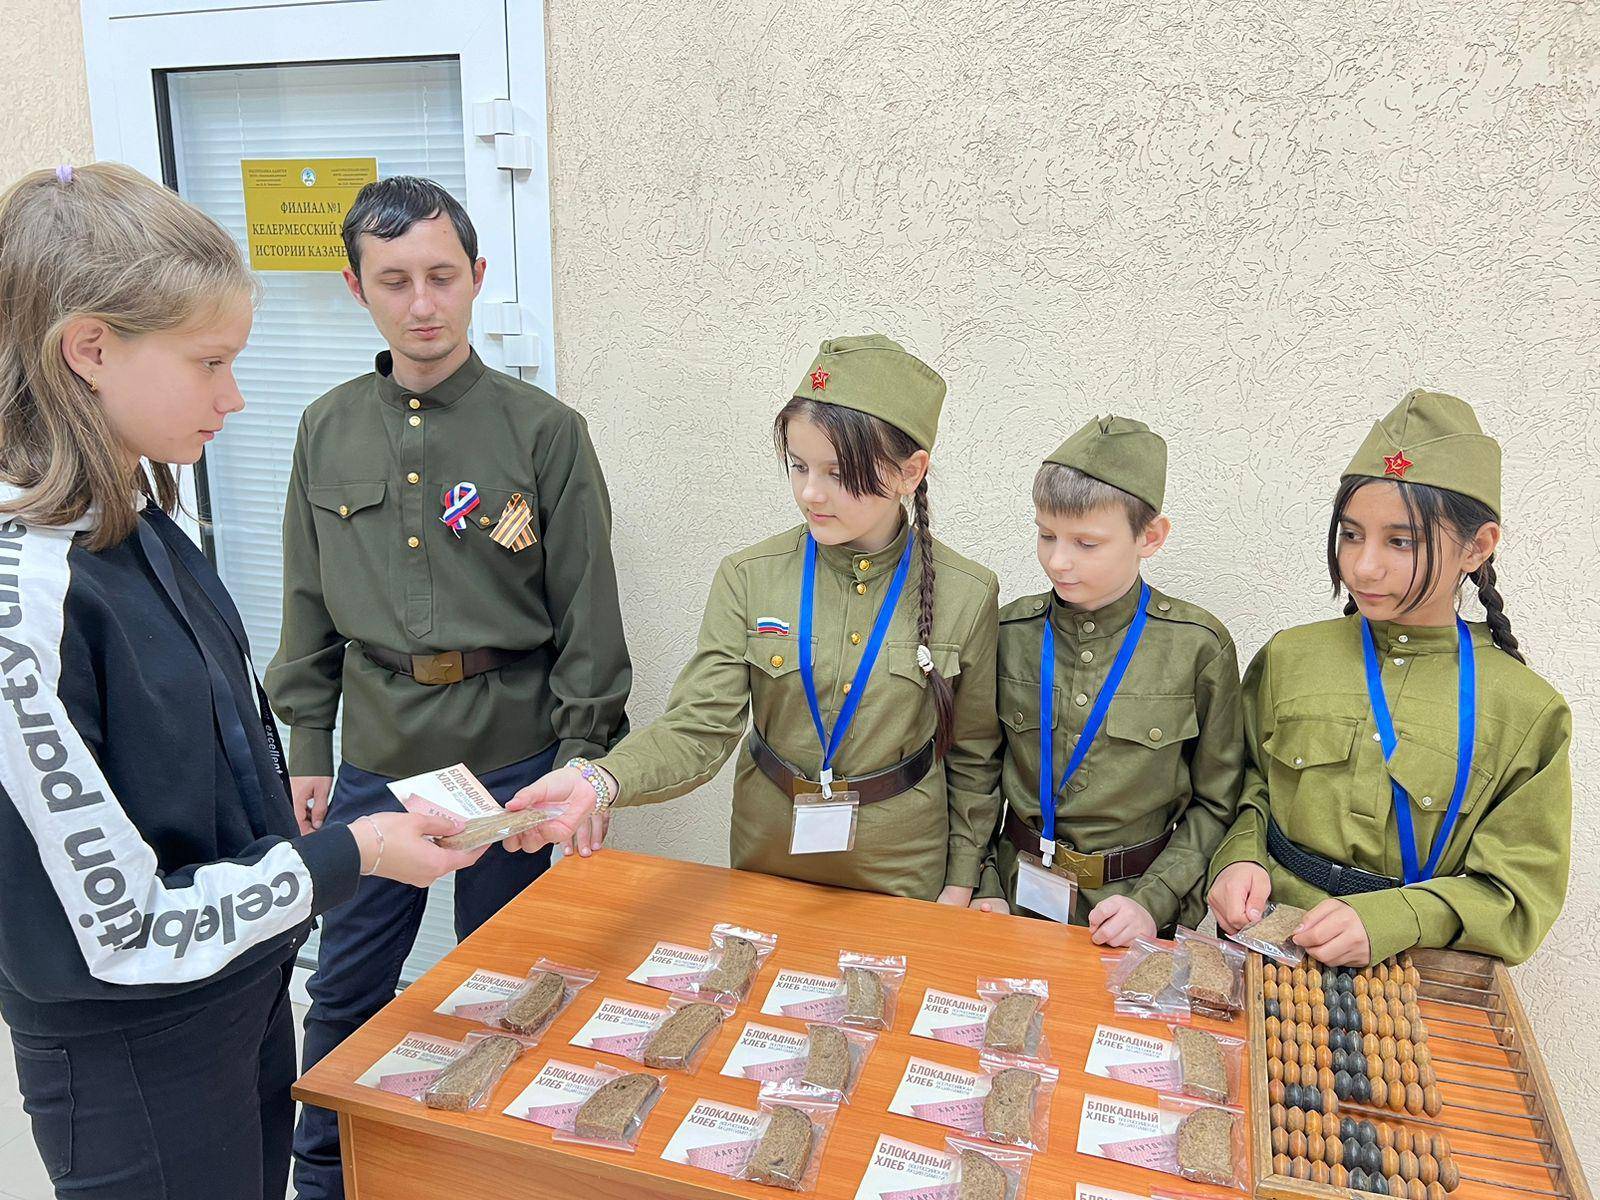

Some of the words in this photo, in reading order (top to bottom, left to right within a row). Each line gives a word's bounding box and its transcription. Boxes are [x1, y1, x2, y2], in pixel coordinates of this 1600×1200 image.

[280, 202, 325, 214] ФИЛИАЛ
[328, 202, 341, 213] №1
[252, 221, 337, 236] КЕЛЕРМЕССКИЙ
[256, 245, 305, 257] ИСТОРИИ
[308, 245, 348, 258] КАЗАЧЕ
[265, 724, 283, 775] excellent
[435, 772, 458, 792] ХЛЕБ
[649, 955, 672, 965] ХЛЕБ
[655, 947, 709, 964] БЛОКАДНЫЙ
[463, 982, 487, 991] ХЛЕБ
[776, 982, 800, 991] ХЛЕБ
[779, 974, 838, 988] БЛОКАДНЫЙ
[924, 1004, 949, 1014] ХЛЕБ
[927, 995, 989, 1014] БЛОКАДНЫЙ
[596, 1012, 621, 1023] ХЛЕБ
[740, 1037, 767, 1049] ХЛЕБ
[1096, 1038, 1123, 1050] ХЛЕБ
[1098, 1030, 1164, 1051] БЛОКАДНЫЙ
[393, 1047, 420, 1059] ХЛЕБ
[906, 1074, 934, 1088] ХЛЕБ
[909, 1063, 976, 1087] БЛОКАДНЫЙ
[535, 1076, 562, 1090] ХЛЕБ
[1085, 1110, 1116, 1124] ХЛЕБ
[1087, 1100, 1159, 1123] БЛОКАДНЫЙ
[688, 1115, 716, 1128] ХЛЕБ
[874, 1154, 905, 1171] ХЛЕБ
[879, 1142, 952, 1170] БЛОКАДНЫЙ
